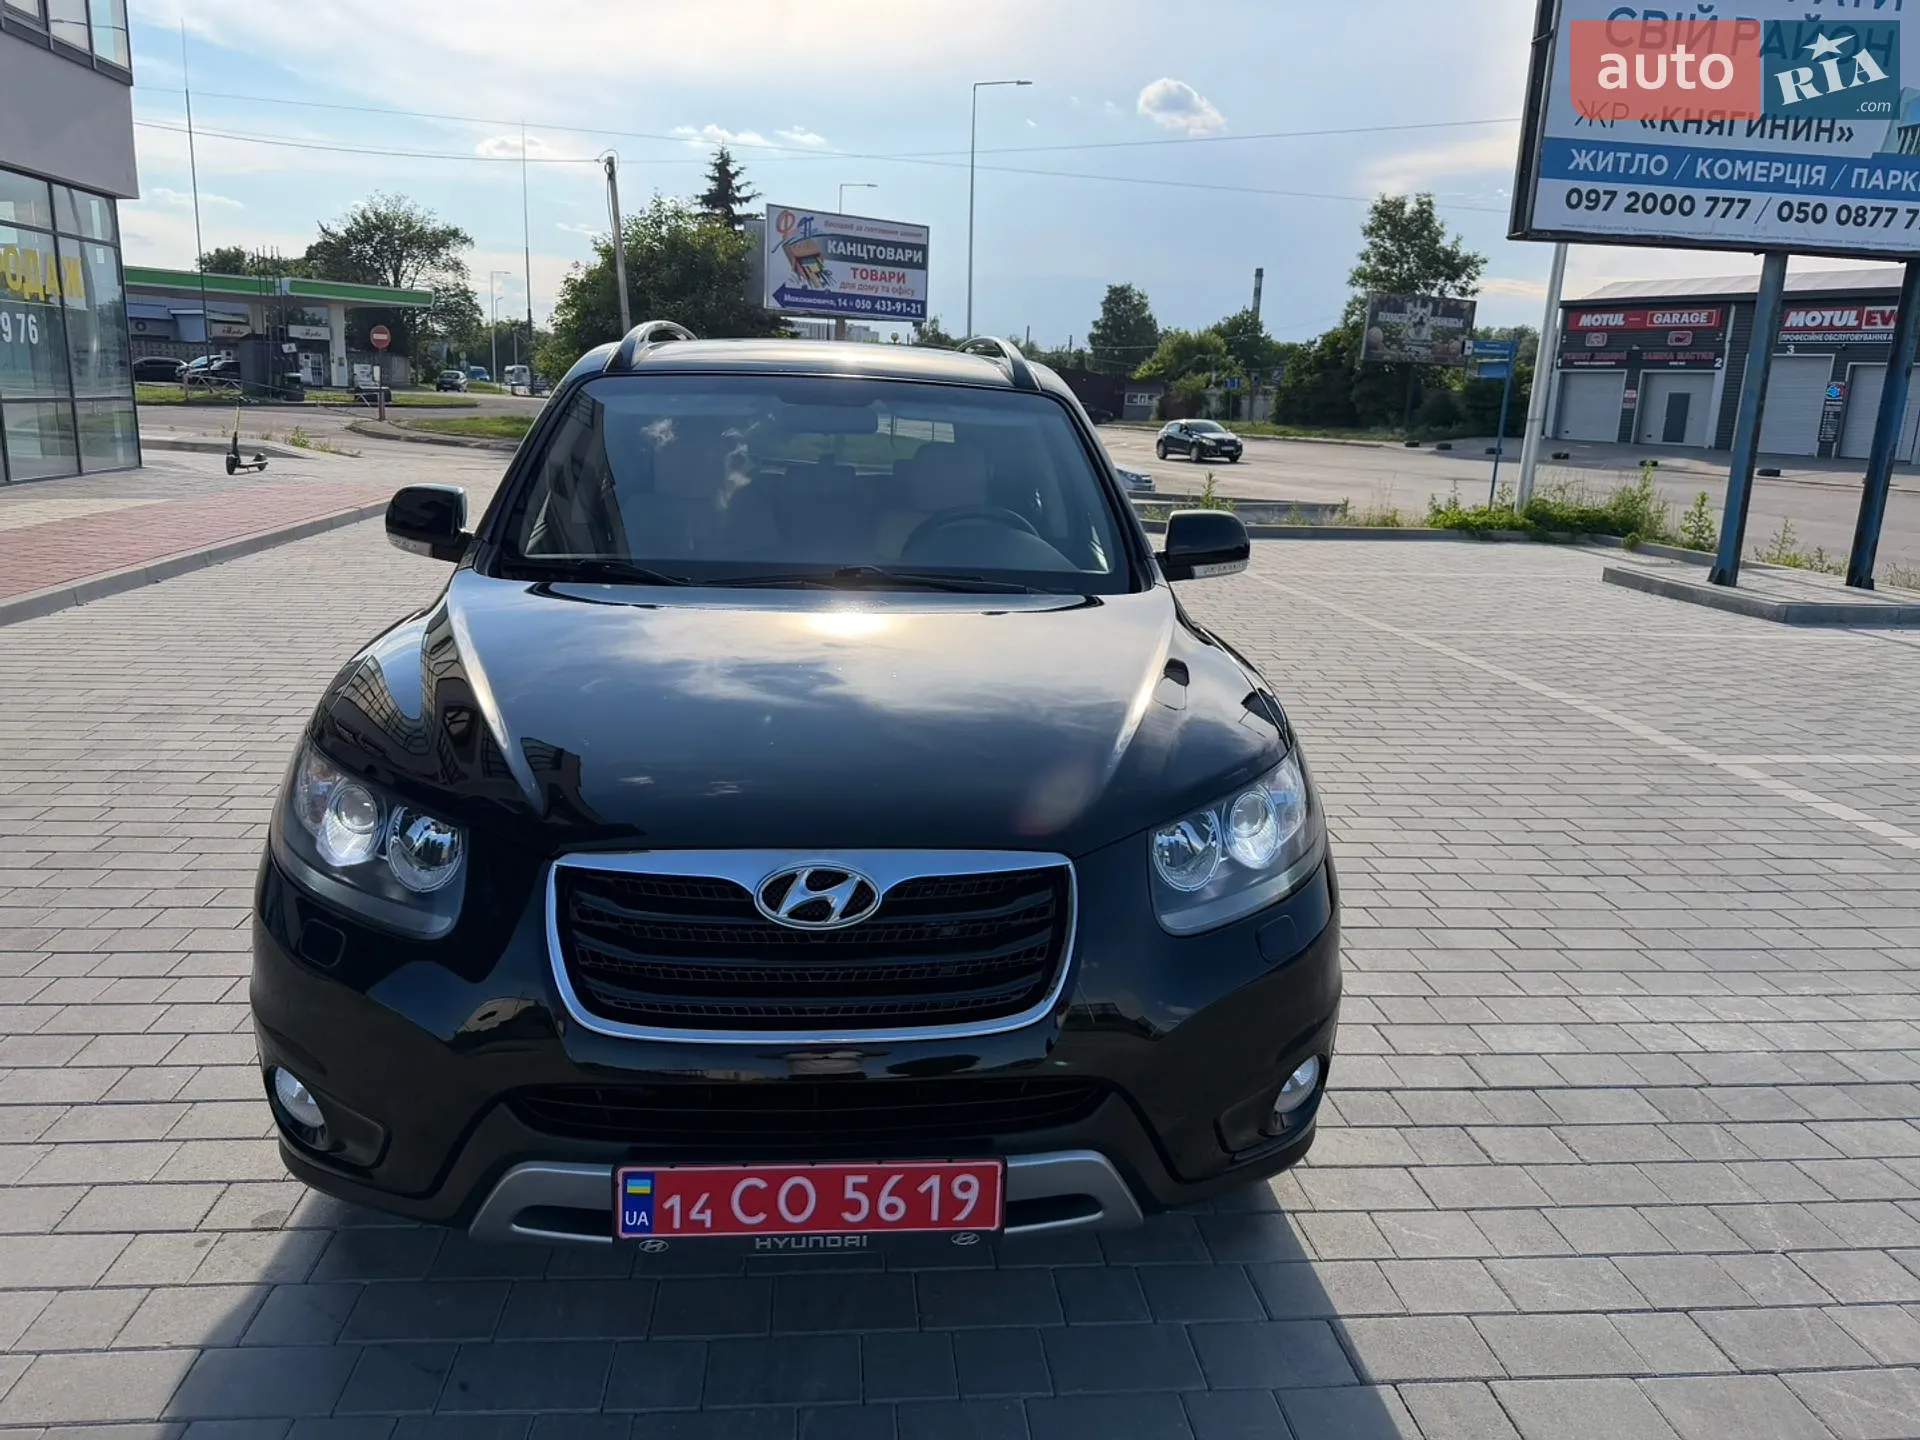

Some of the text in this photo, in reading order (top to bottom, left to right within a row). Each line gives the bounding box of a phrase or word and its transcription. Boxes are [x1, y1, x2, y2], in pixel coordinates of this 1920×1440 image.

[1605, 4, 1719, 54] СВІЙ
[1574, 100, 1854, 143] ЖР «КНЯГИНИН»
[1568, 148, 1669, 176] ЖИТЛО
[1695, 157, 1827, 188] КОМЕРЦІЯ
[1851, 167, 1920, 192] ПАРК
[1565, 187, 1618, 212] 097
[1624, 191, 1696, 217] 2000
[1704, 196, 1752, 220] 777
[1777, 200, 1828, 224] 050
[1835, 204, 1898, 228] 0877
[1904, 208, 1920, 231] 7
[827, 240, 923, 263] КАНЦТОВАРИ
[0, 245, 85, 300] ОДАЖ
[850, 267, 907, 284] ТОВАРИ
[857, 282, 879, 294] дому
[880, 284, 890, 292] та
[838, 298, 848, 307] 14
[855, 299, 871, 310] 050
[875, 300, 921, 314] 433-91-21
[1579, 311, 1708, 327] MOTUL GARAGE
[1784, 310, 1859, 327] MOTUL
[1787, 345, 1795, 354] 3
[1714, 357, 1723, 368] 2
[661, 1173, 980, 1229] 14 CO 5619
[625, 1211, 649, 1226] UA
[755, 1235, 868, 1250] HYUNDAI
